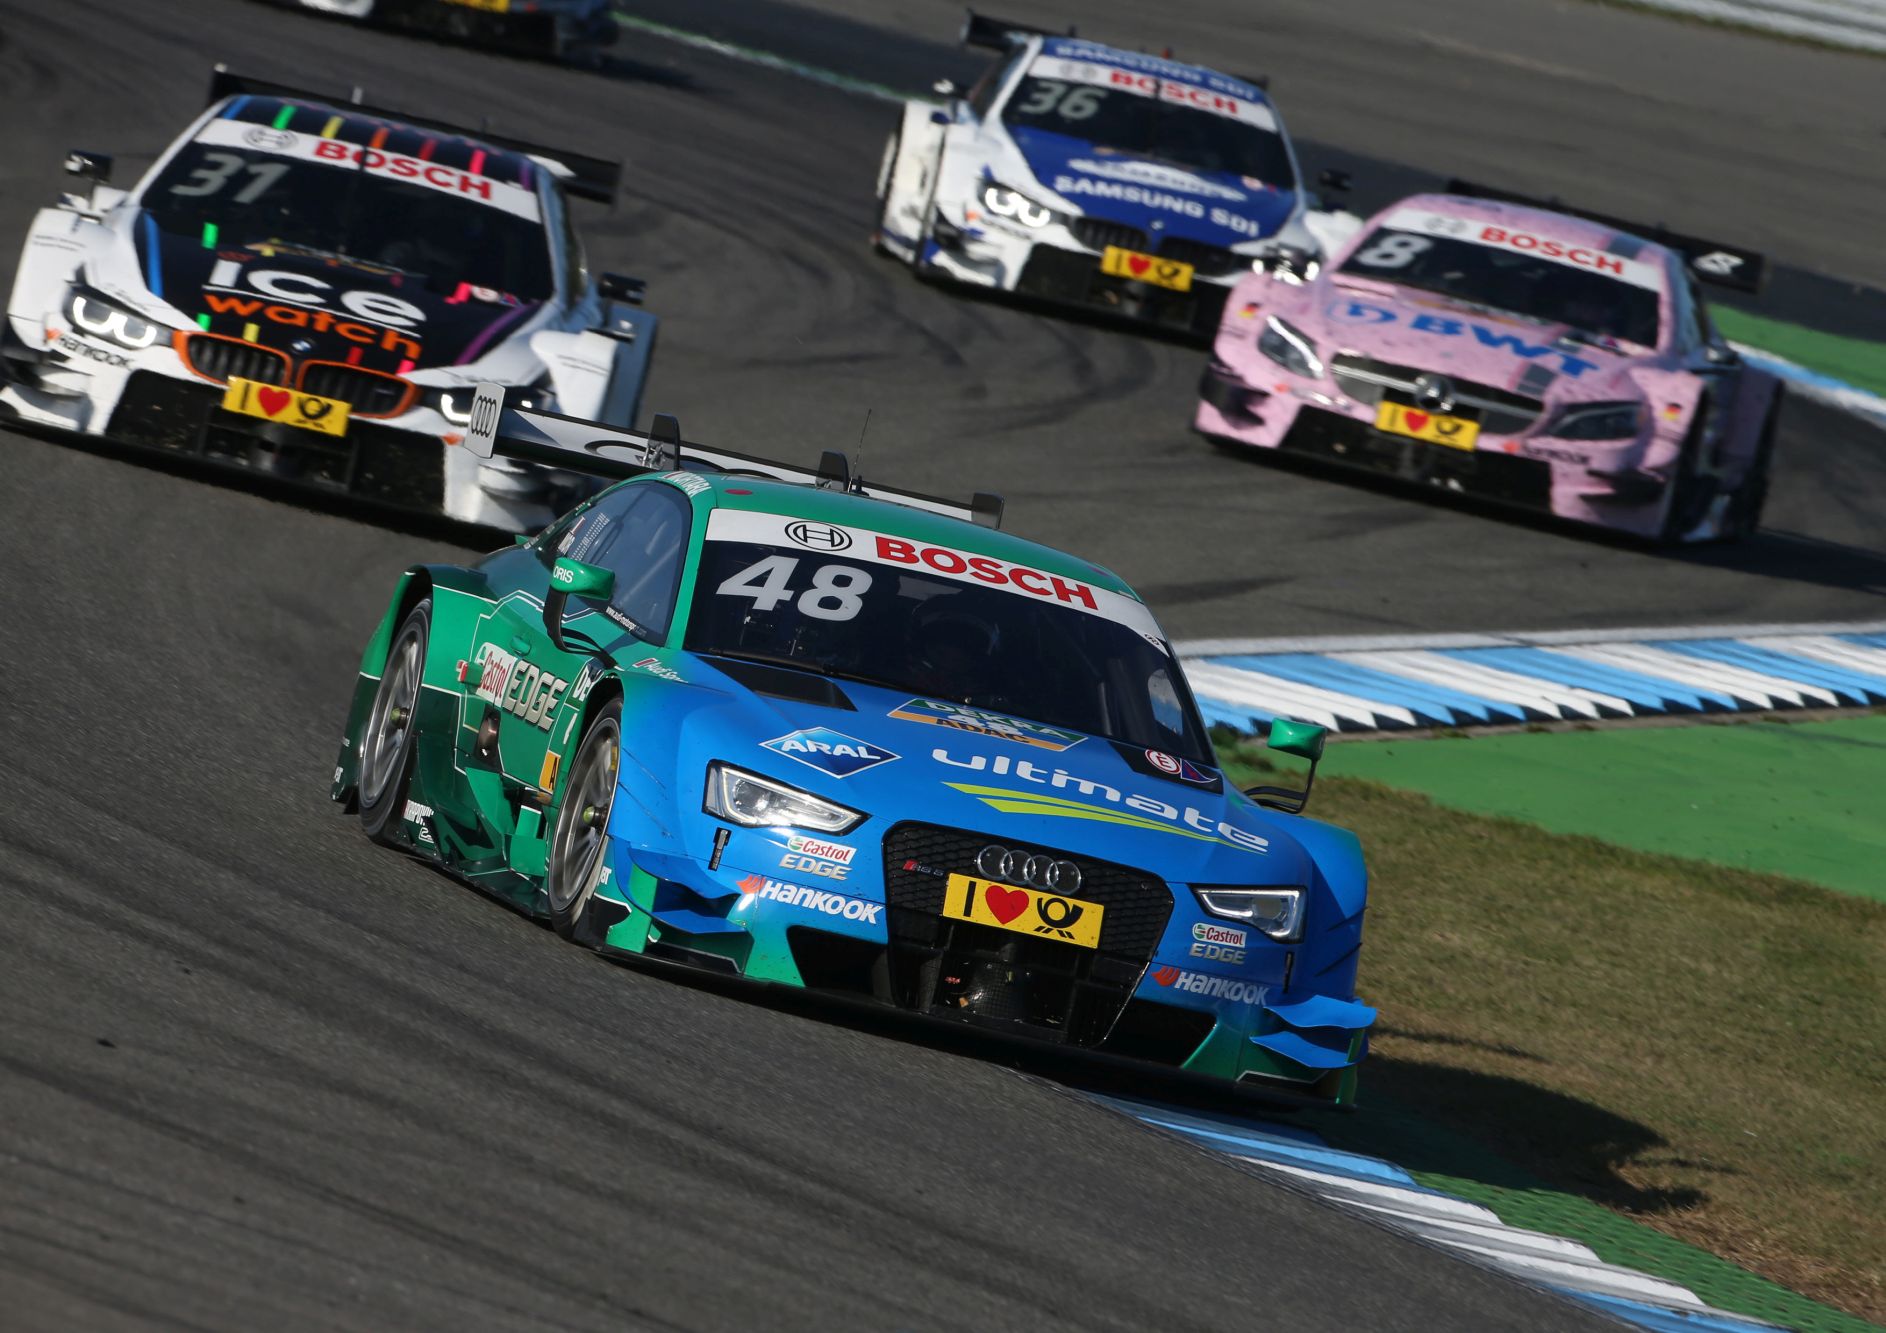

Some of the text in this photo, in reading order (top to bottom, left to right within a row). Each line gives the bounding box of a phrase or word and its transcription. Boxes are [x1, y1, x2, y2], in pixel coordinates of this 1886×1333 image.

[1018, 80, 1108, 119] 36
[1109, 69, 1239, 115] BOSCH
[168, 151, 291, 203] 31
[313, 140, 492, 201] BOSCH
[1053, 175, 1205, 219] SAMSUNG
[1210, 207, 1260, 238] SDI
[1354, 232, 1435, 268] 8
[1480, 226, 1625, 275] BOSCH
[204, 294, 422, 360] watch
[1409, 313, 1600, 379] BWT
[552, 566, 575, 583] ORIS
[716, 554, 873, 622] 48
[876, 535, 1098, 611] BOSCH
[479, 650, 512, 698] Castrol
[502, 659, 570, 732] EDGE
[924, 700, 1069, 740] DEKRA
[937, 718, 1031, 743] ADAC
[948, 714, 1024, 736] 48
[780, 739, 881, 760] ARAL
[932, 748, 1269, 853] ultimate
[779, 853, 853, 881] EDGE
[802, 840, 851, 862] Castrol
[963, 880, 977, 917] I
[1188, 942, 1248, 966] EDGE
[1206, 927, 1243, 946] Castrol
